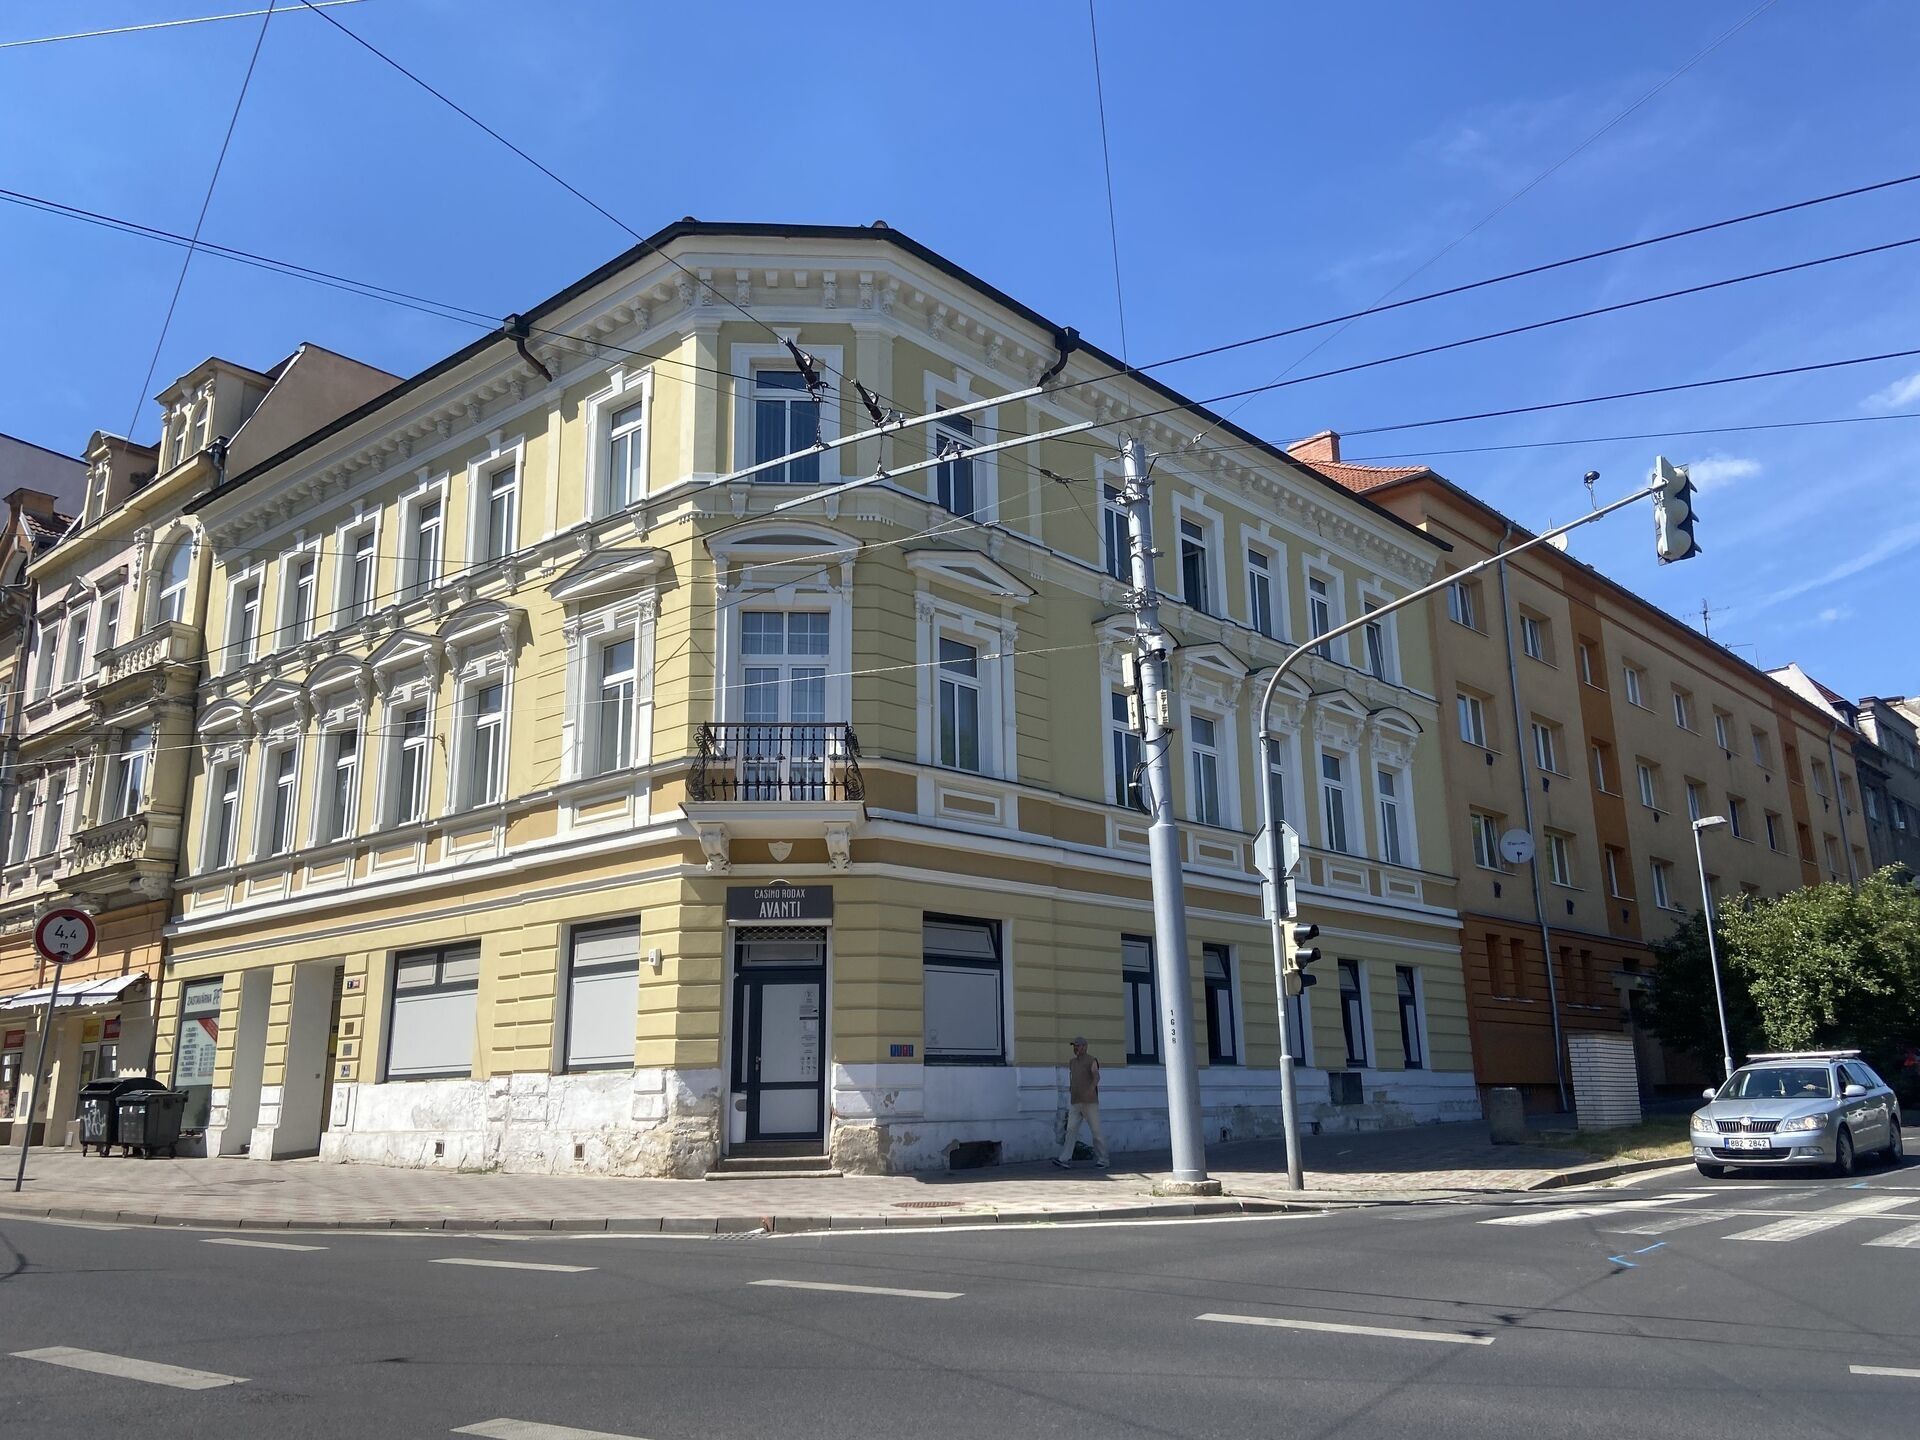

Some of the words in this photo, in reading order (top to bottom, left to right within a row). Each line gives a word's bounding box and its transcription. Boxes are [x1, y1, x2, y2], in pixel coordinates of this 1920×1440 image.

[754, 889, 780, 899] CASINO
[782, 888, 806, 899] RODAX
[759, 901, 801, 918] AVANTI
[54, 924, 77, 939] 4,4
